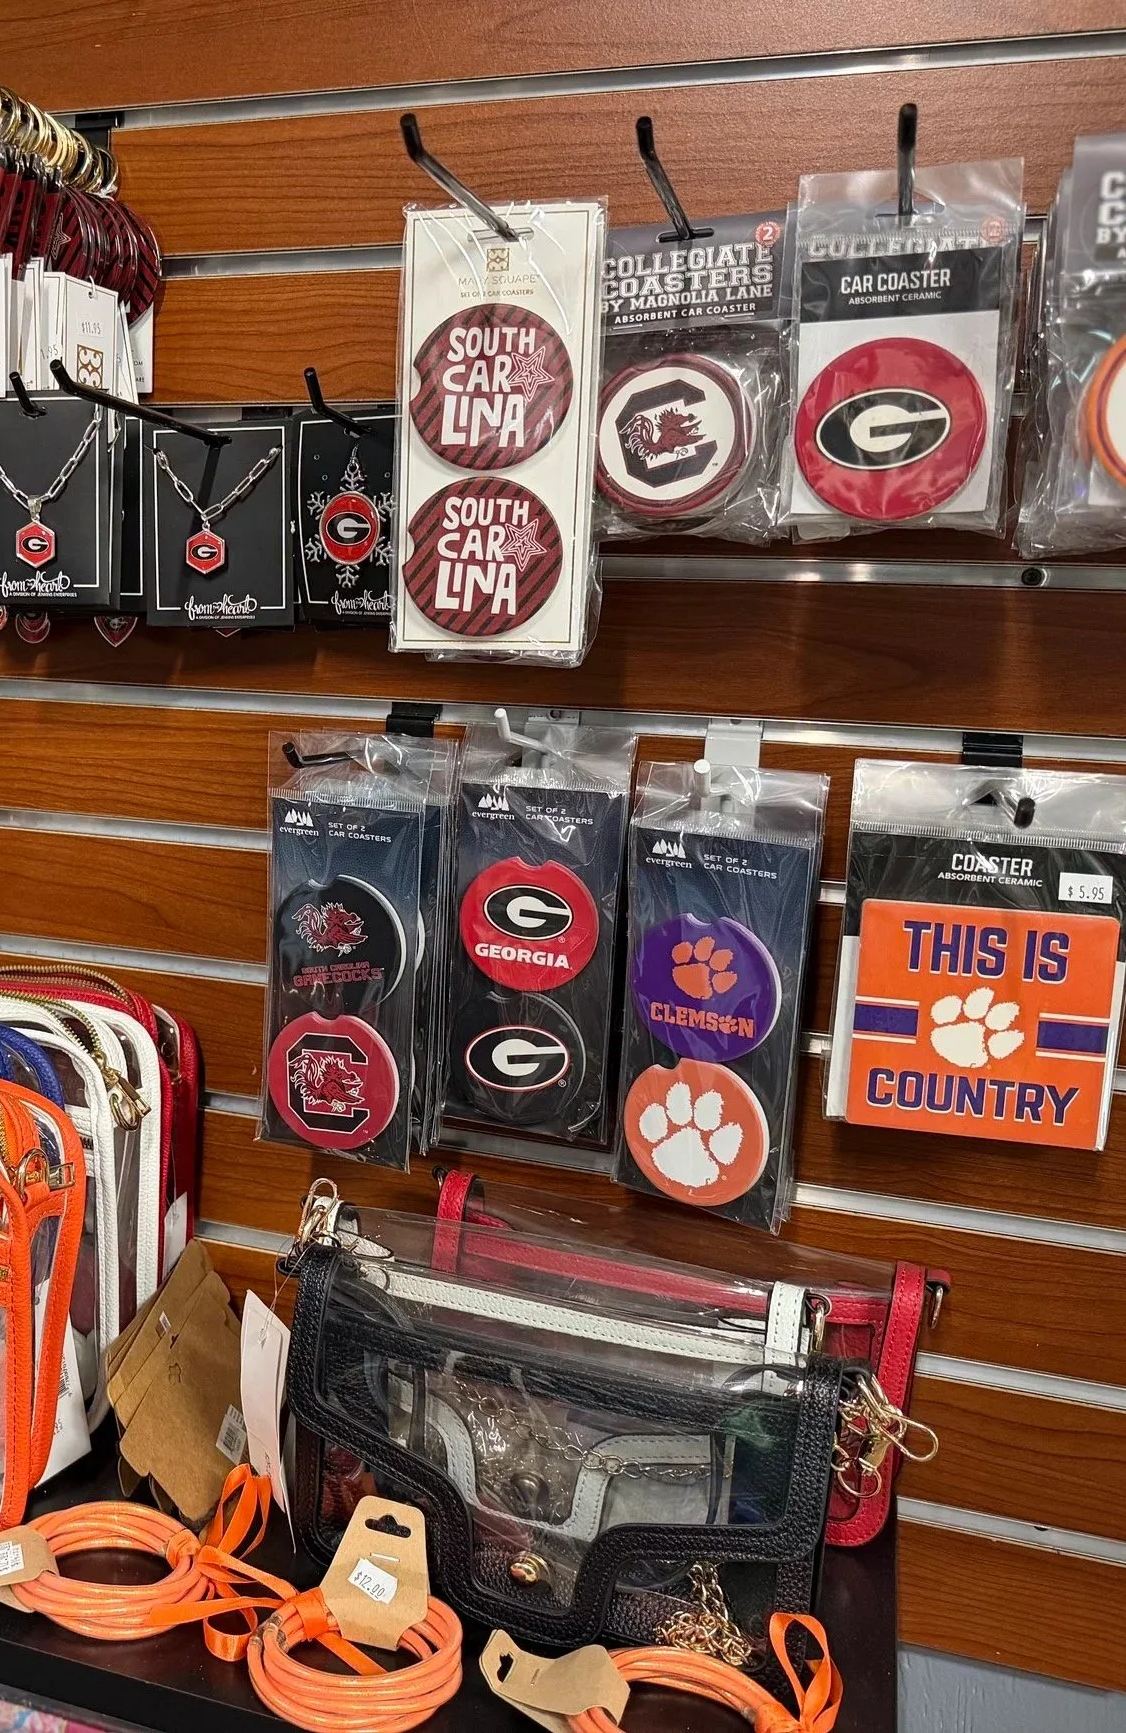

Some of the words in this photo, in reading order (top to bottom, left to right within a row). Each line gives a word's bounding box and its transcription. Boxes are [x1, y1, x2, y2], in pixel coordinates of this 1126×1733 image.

[762, 226, 773, 241] 2
[602, 242, 773, 279] COLLEGIATE
[458, 277, 489, 286] MAY
[602, 264, 773, 299] COASTERS
[841, 275, 873, 294] CAR
[877, 269, 951, 291] COASTER
[601, 298, 624, 313] BY
[630, 289, 719, 311] MAGNOLIA
[726, 284, 773, 301] LANE
[849, 294, 900, 305] ABSORBENT
[902, 291, 942, 301] CERAMIC
[615, 310, 677, 324] ABSORBENT
[681, 306, 702, 317] CAR
[707, 303, 756, 314] COASTER
[447, 327, 536, 362] SOUTH
[440, 393, 525, 447] LINA
[442, 496, 529, 530] SOUTH
[434, 561, 516, 616] LINA
[472, 810, 515, 820] evergreen
[525, 813, 544, 821] CAR
[547, 815, 594, 825] COASTERS
[279, 826, 319, 837] evergreen
[348, 833, 392, 843] COASTERS
[645, 856, 692, 869] evergreen
[703, 853, 721, 862] SET
[725, 856, 739, 864] OF
[703, 862, 723, 871] CAR
[726, 866, 777, 880] COASTERS
[951, 853, 1034, 877] COASTER
[937, 871, 996, 884] ABSORBENT
[998, 876, 1043, 888] CERAMIC
[1079, 886, 1105, 900] 5.95
[474, 942, 570, 969] GEORGIA
[903, 919, 1009, 978] THIS
[1022, 928, 1070, 985] IS
[293, 968, 384, 987] GAMECOCKS
[866, 1067, 1080, 1126] COUNTRY
[354, 1571, 386, 1599] $12.00
